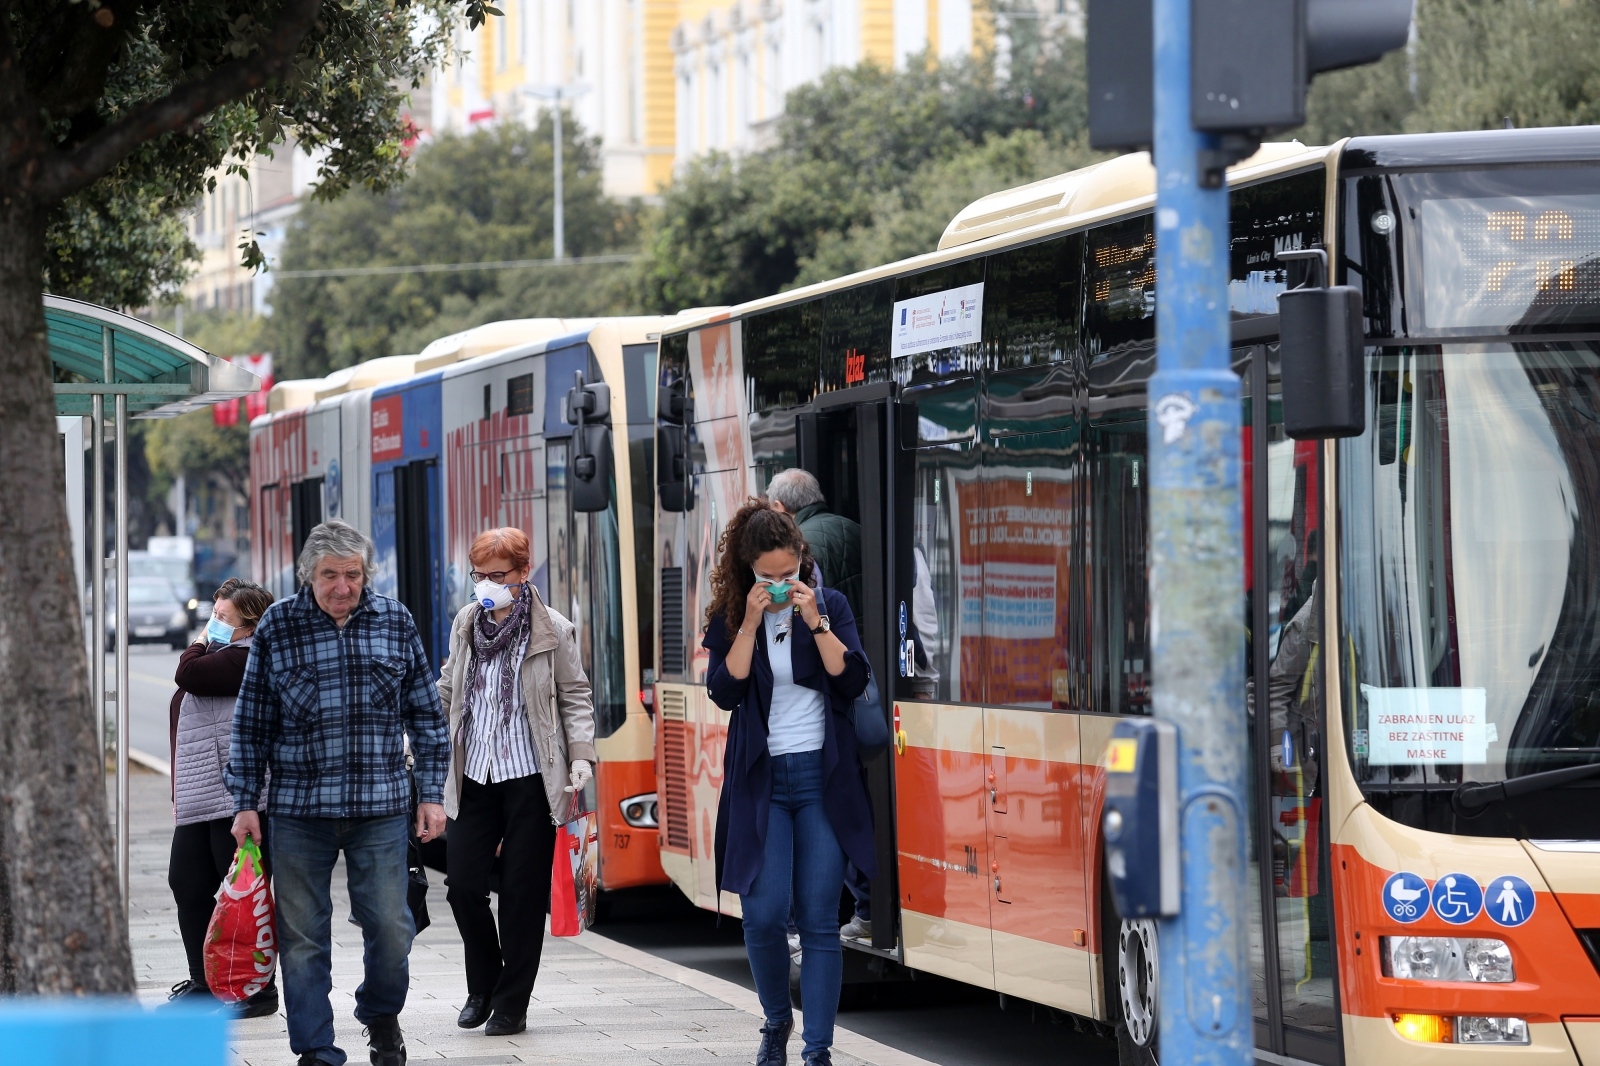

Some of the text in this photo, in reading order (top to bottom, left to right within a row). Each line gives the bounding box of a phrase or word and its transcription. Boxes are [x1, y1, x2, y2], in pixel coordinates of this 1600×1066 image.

[1274, 232, 1303, 258] MAN
[1246, 251, 1271, 264] Lion's City
[846, 348, 865, 383] Izlaz
[1378, 715, 1475, 724] ZABRANJEN ULAZ
[1389, 730, 1464, 742] BEZ ZAŠTITNE
[1407, 749, 1447, 759] MASKE
[614, 834, 631, 849] 737
[965, 844, 978, 879] 744
